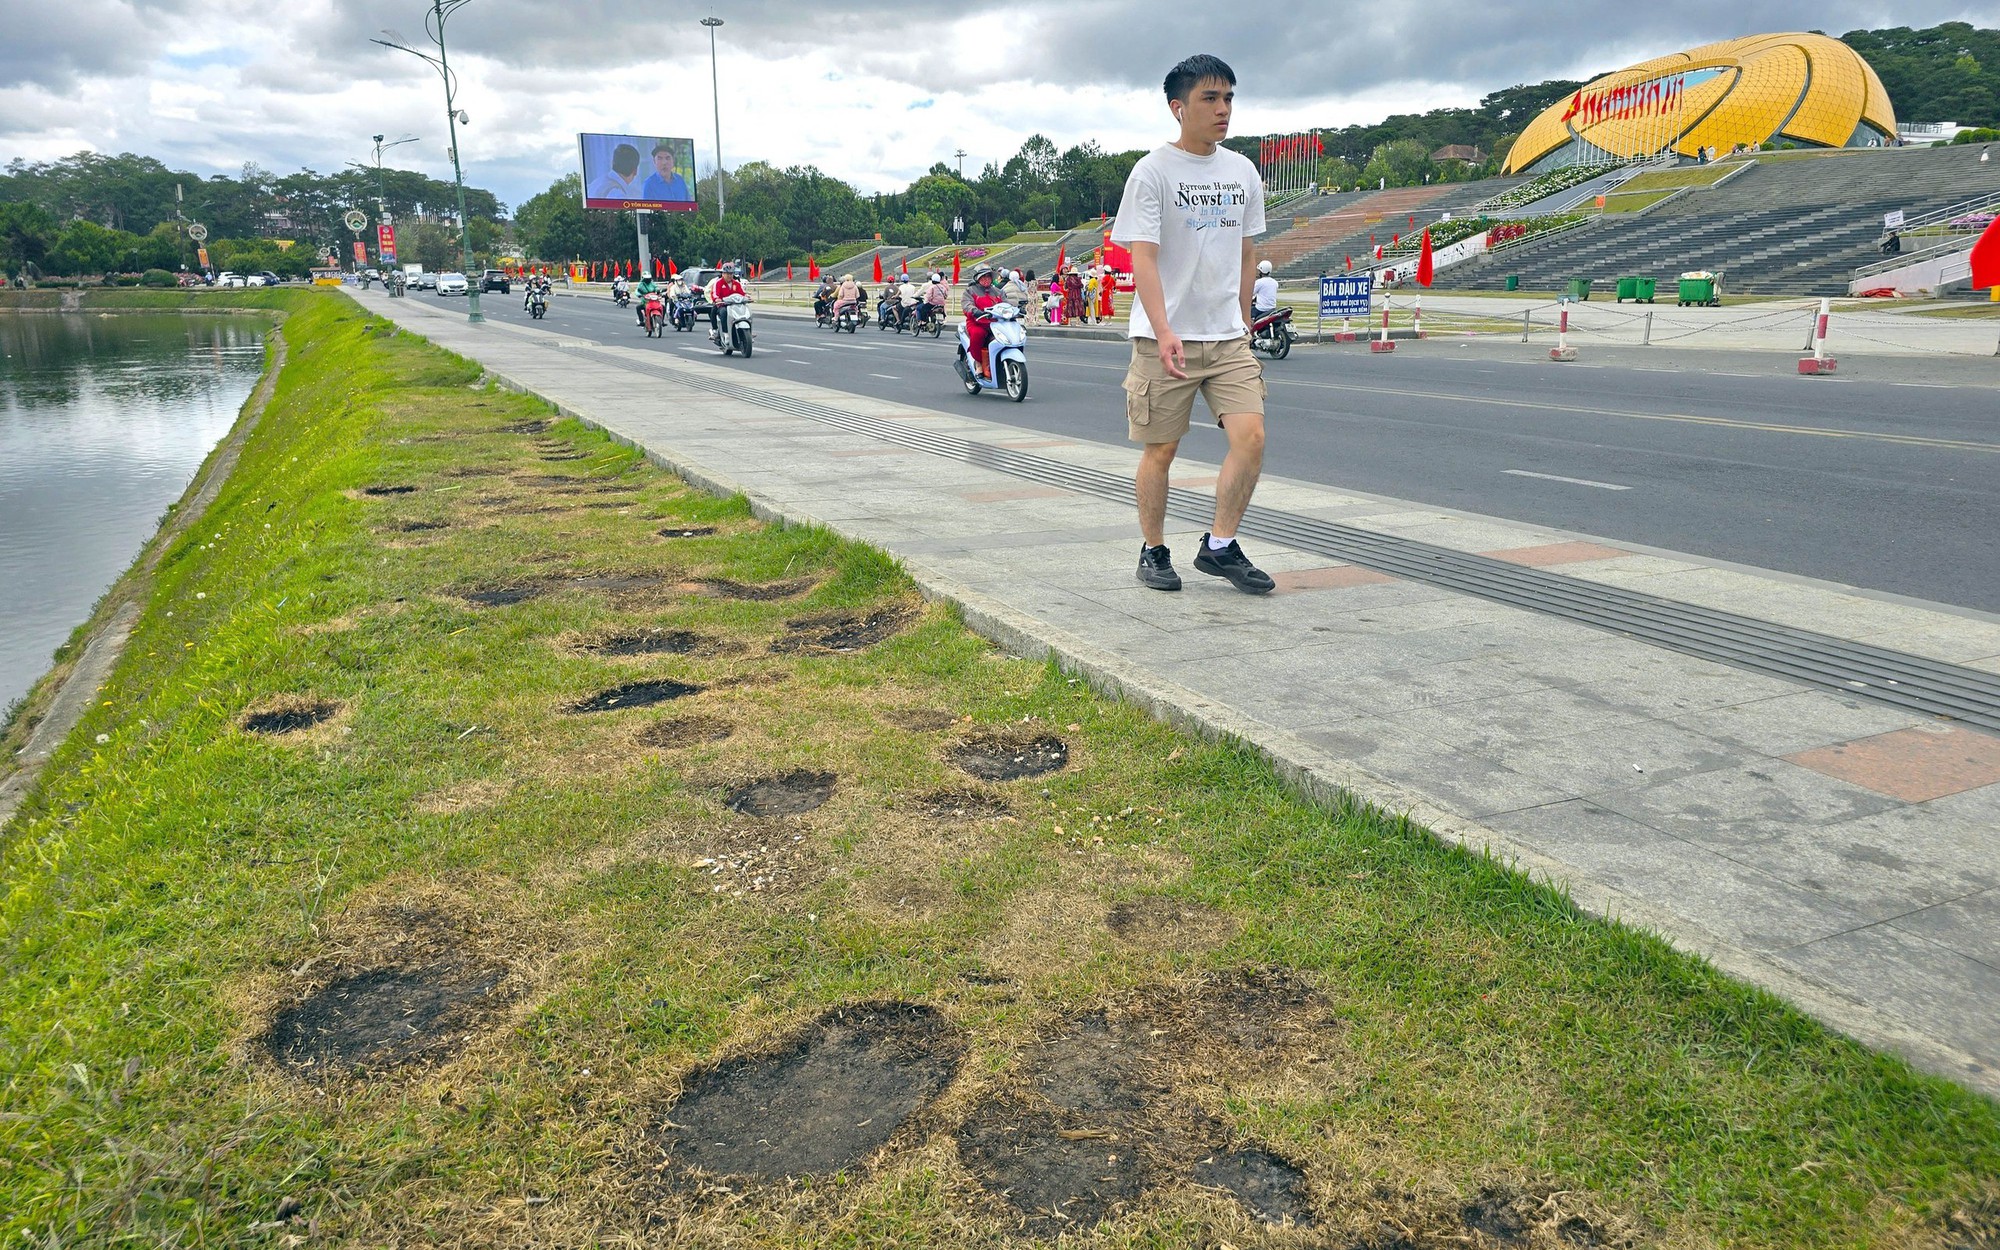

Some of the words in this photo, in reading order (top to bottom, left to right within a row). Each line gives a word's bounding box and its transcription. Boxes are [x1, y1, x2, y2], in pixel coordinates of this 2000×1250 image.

[1323, 280, 1337, 296] BÃI
[1339, 279, 1356, 298] ĐẬU
[1357, 282, 1368, 295] XE
